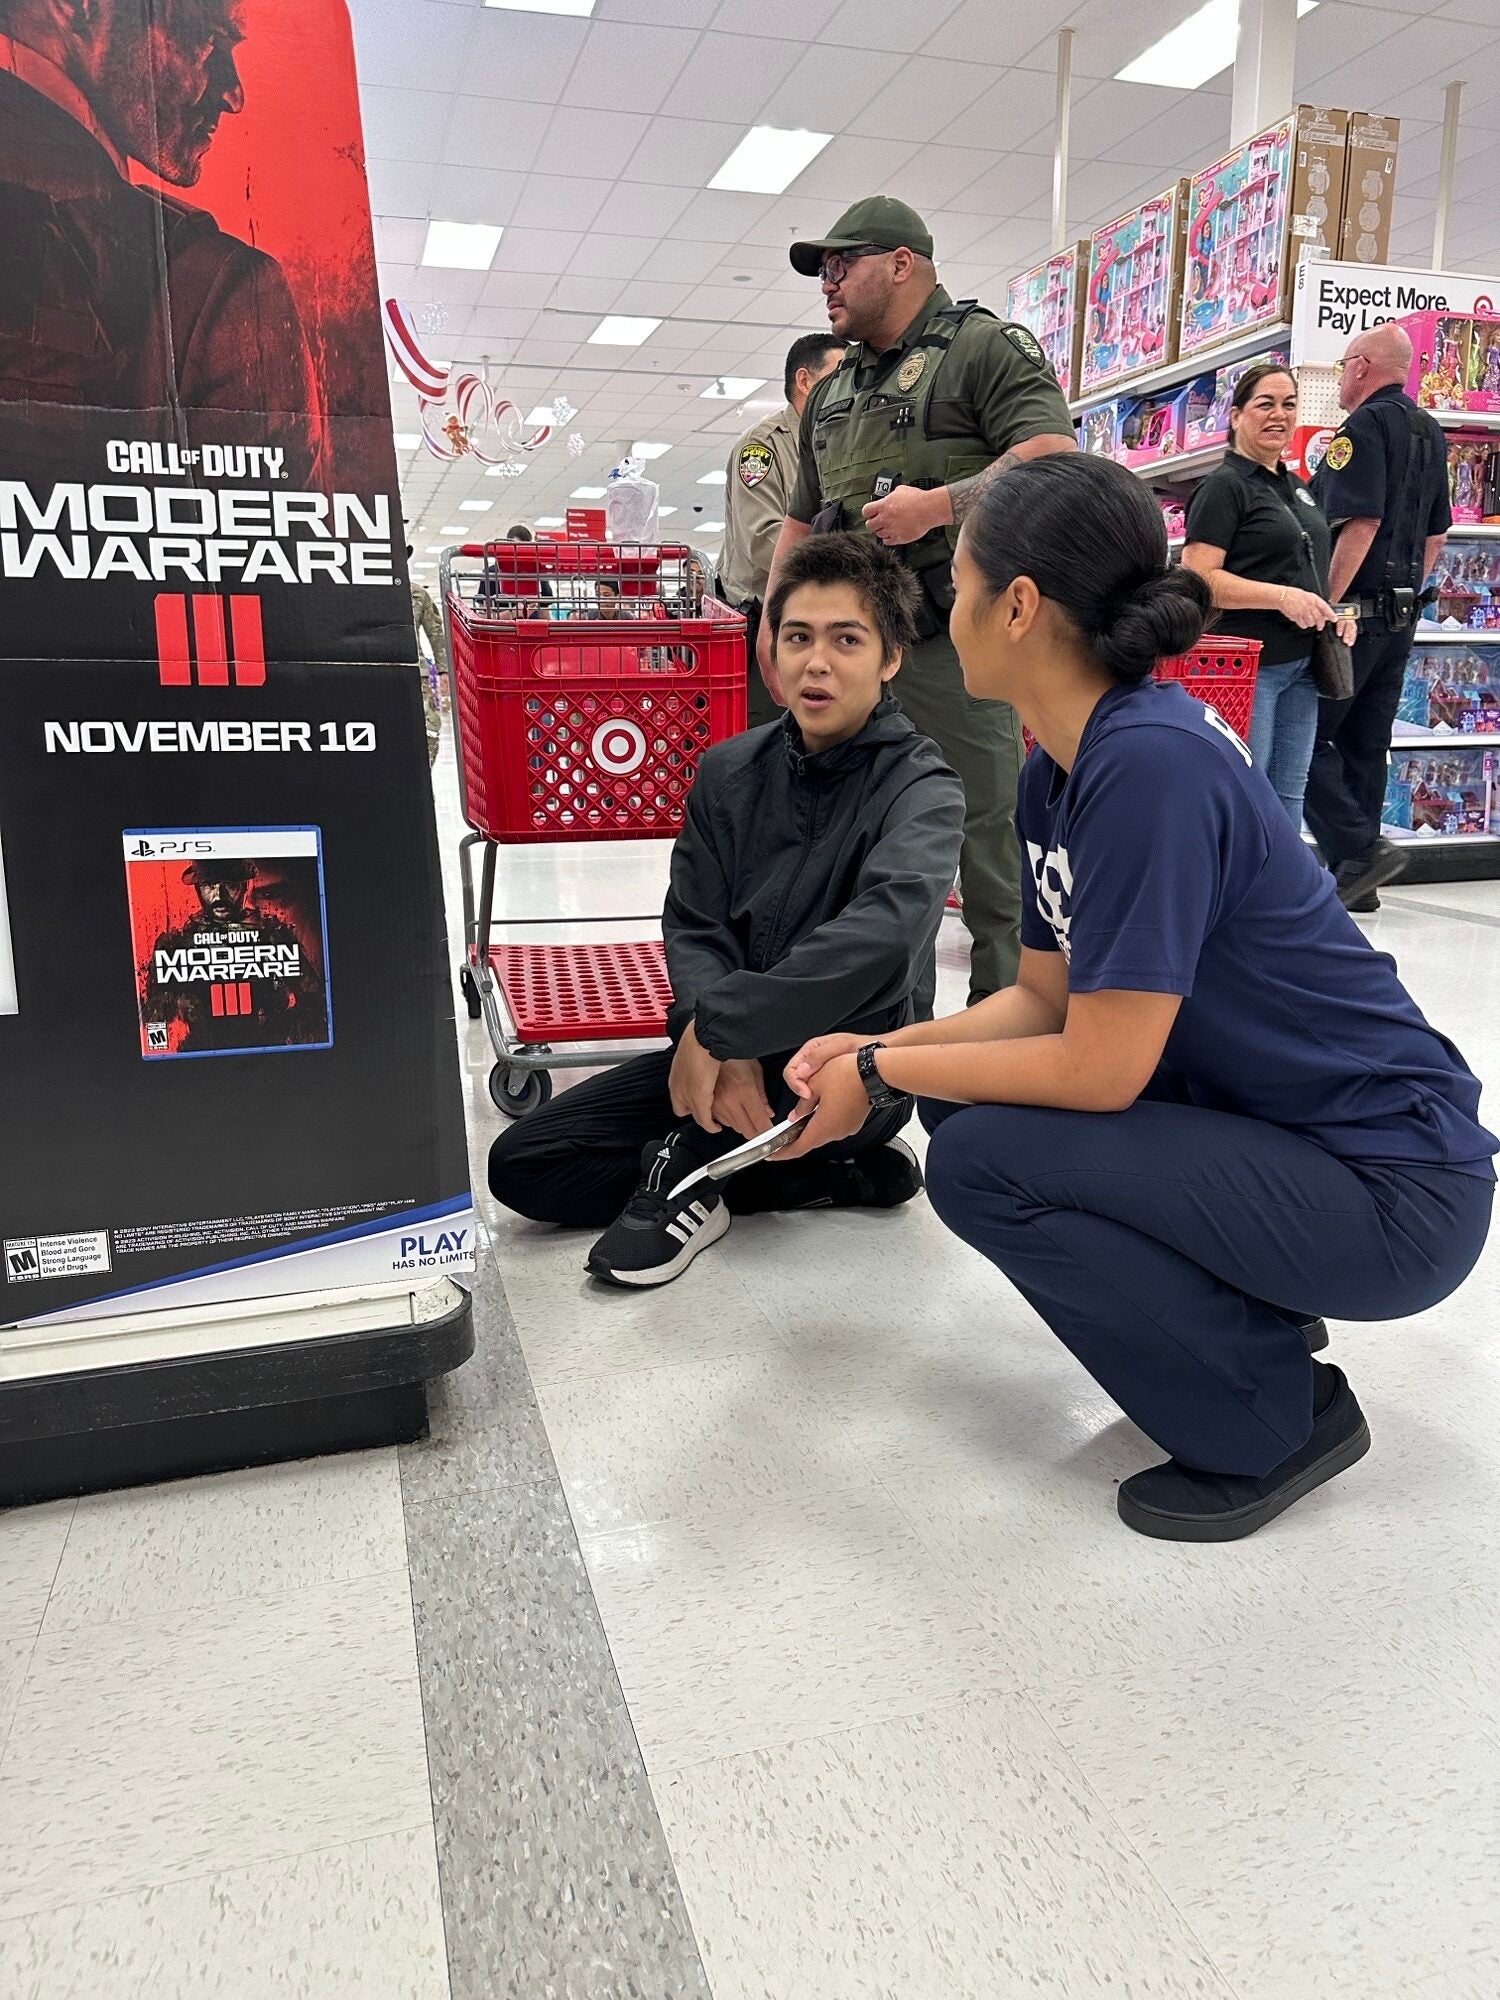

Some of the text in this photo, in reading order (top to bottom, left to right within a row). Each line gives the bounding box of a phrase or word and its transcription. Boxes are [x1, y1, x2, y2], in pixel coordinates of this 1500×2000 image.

[1320, 279, 1450, 312] Expect More.
[1318, 305, 1356, 335] Pay
[106, 440, 284, 478] CALL OF DUTY
[876, 480, 890, 492] TQ
[0, 480, 391, 540] MODERN
[1, 533, 394, 585] WARFARE
[154, 593, 267, 686] III
[44, 721, 377, 753] NOVEMBER 10
[160, 840, 212, 854] PS5
[193, 931, 221, 945] CALL
[228, 930, 259, 944] DUTY
[155, 943, 300, 967] MODERN
[156, 960, 301, 984] WARFARE
[210, 982, 253, 1017] III
[149, 1030, 167, 1045] M
[40, 1236, 98, 1248] Intense Violence
[41, 1244, 96, 1256] Blood and Gore
[401, 1229, 468, 1258] PLAY
[9, 1249, 37, 1274] M
[42, 1253, 102, 1266] Strong Language
[43, 1262, 88, 1274] Use of Drugs
[392, 1250, 475, 1270] HAS NO LIMITS
